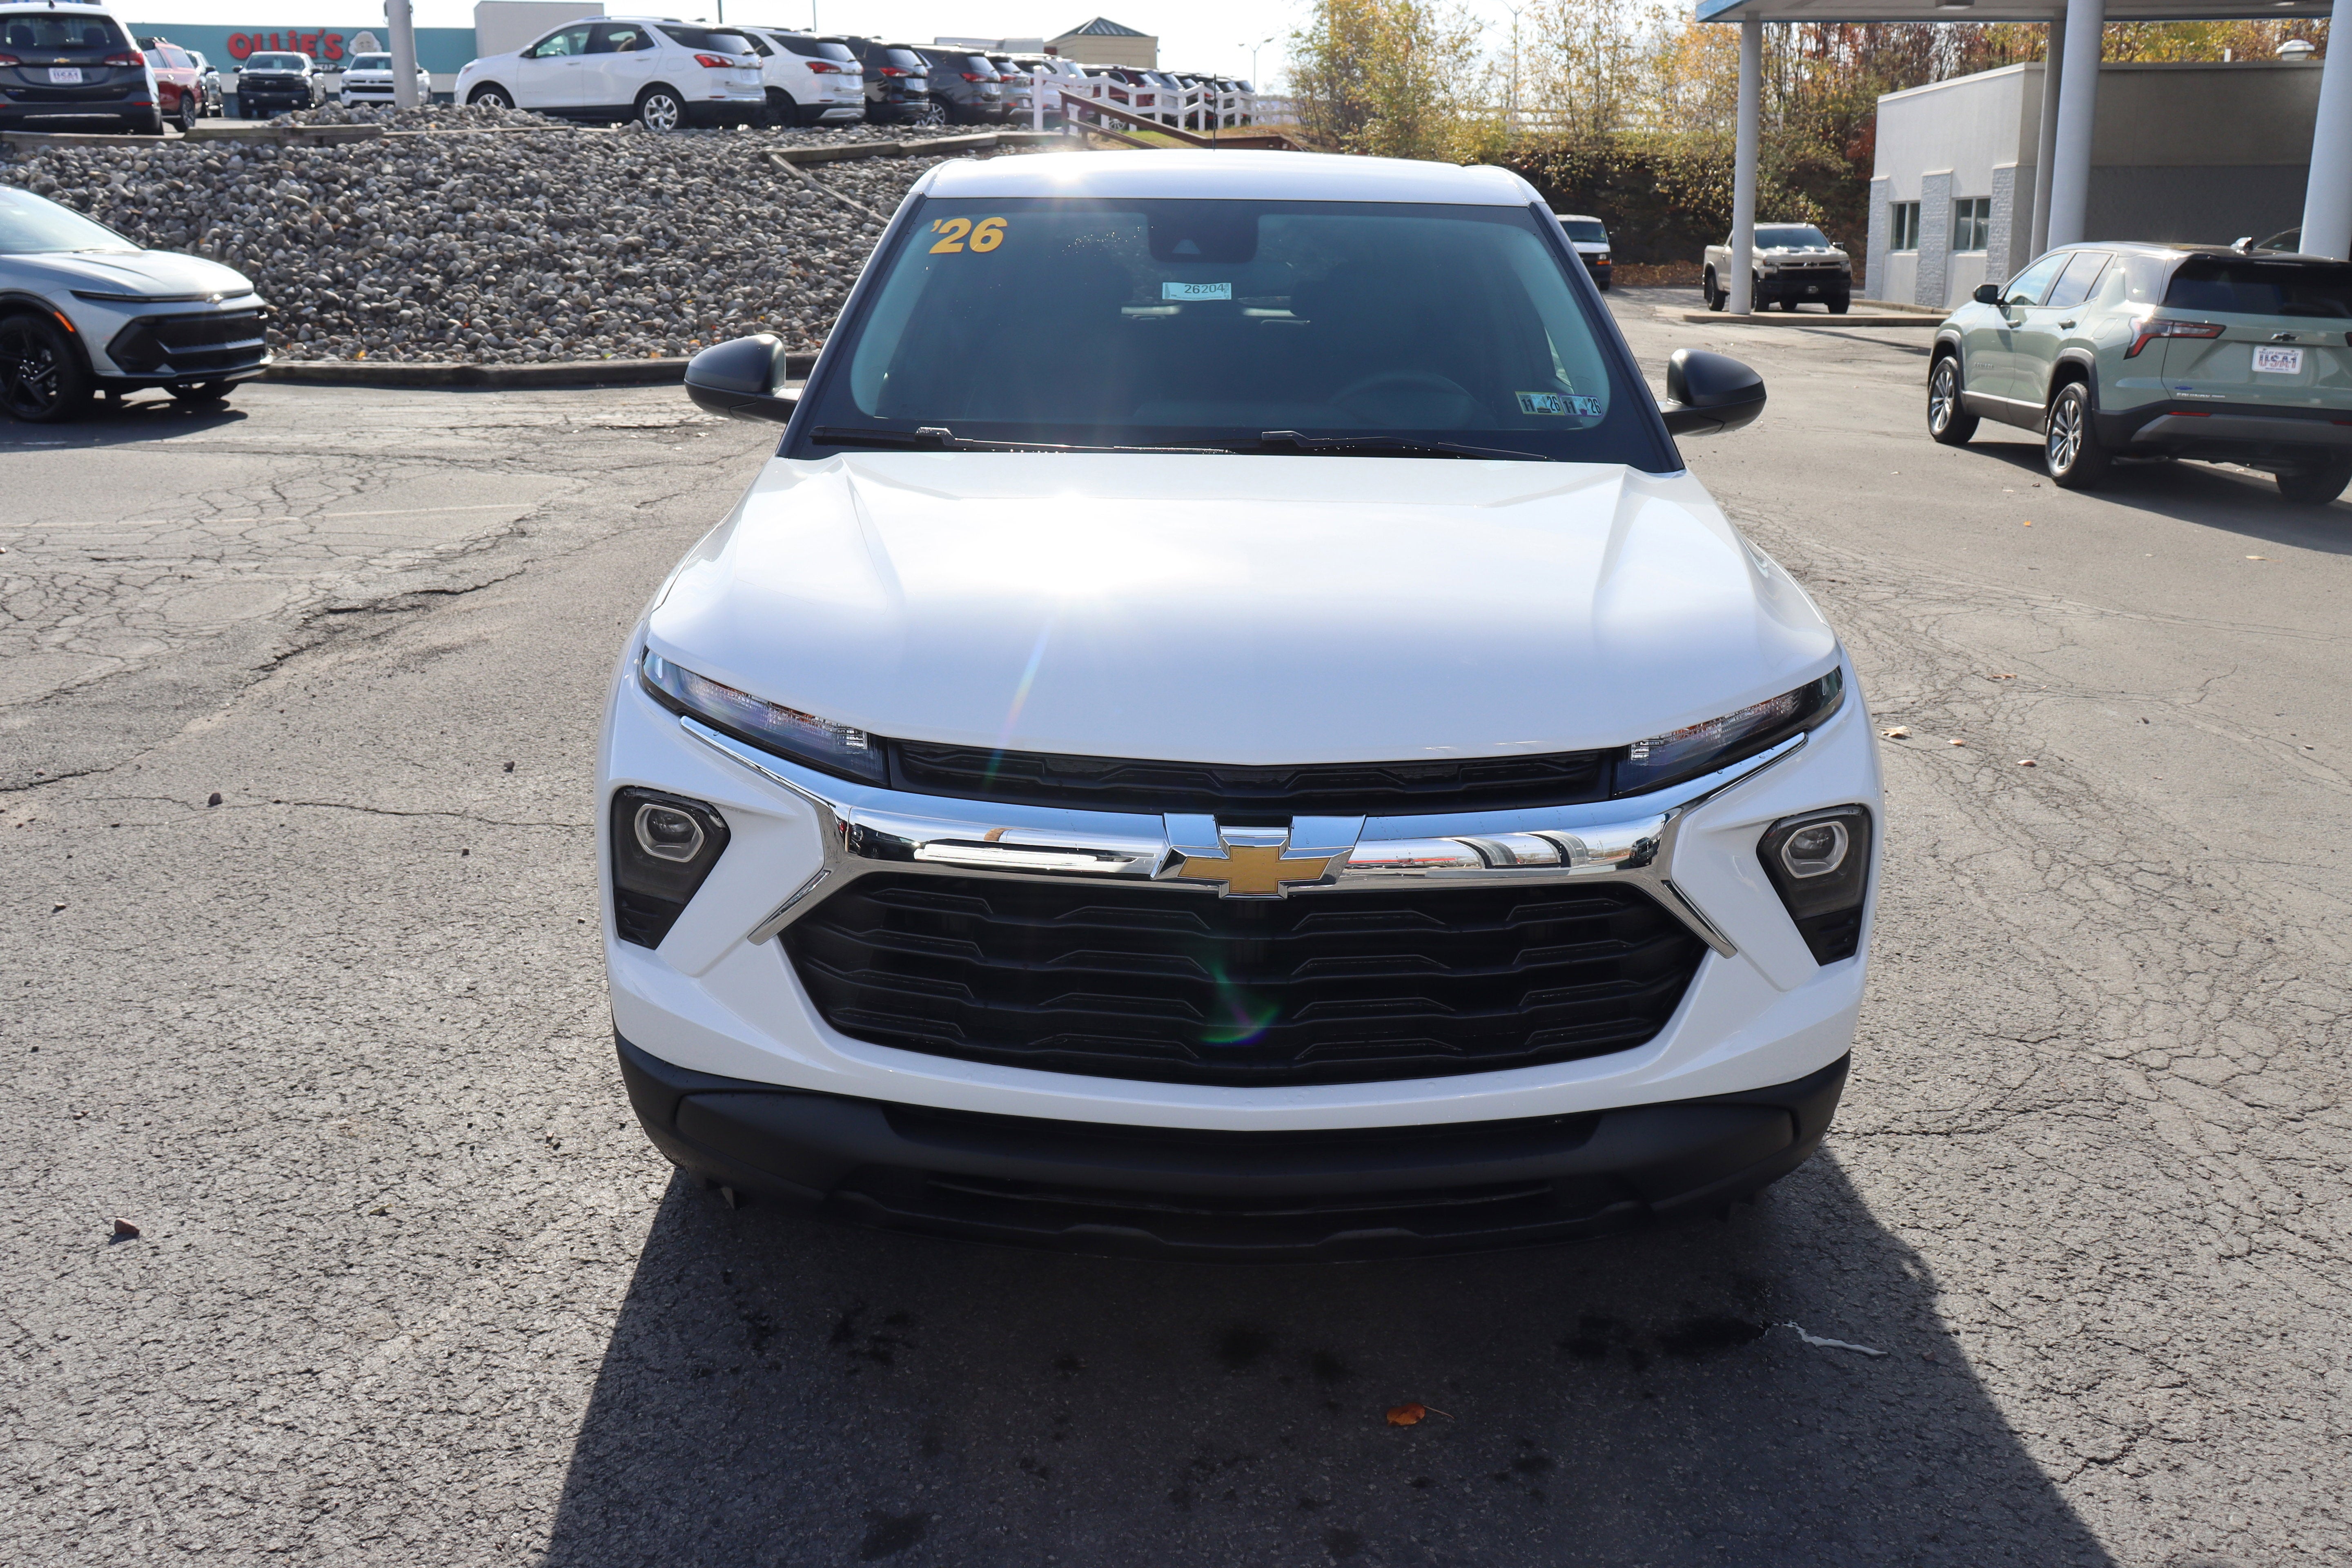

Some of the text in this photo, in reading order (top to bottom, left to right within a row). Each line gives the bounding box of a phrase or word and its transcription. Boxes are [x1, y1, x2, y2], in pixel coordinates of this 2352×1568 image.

[929, 217, 1007, 254] '26
[1184, 284, 1225, 294] 26204
[1547, 396, 1561, 411] 26
[1588, 398, 1601, 413] 26
